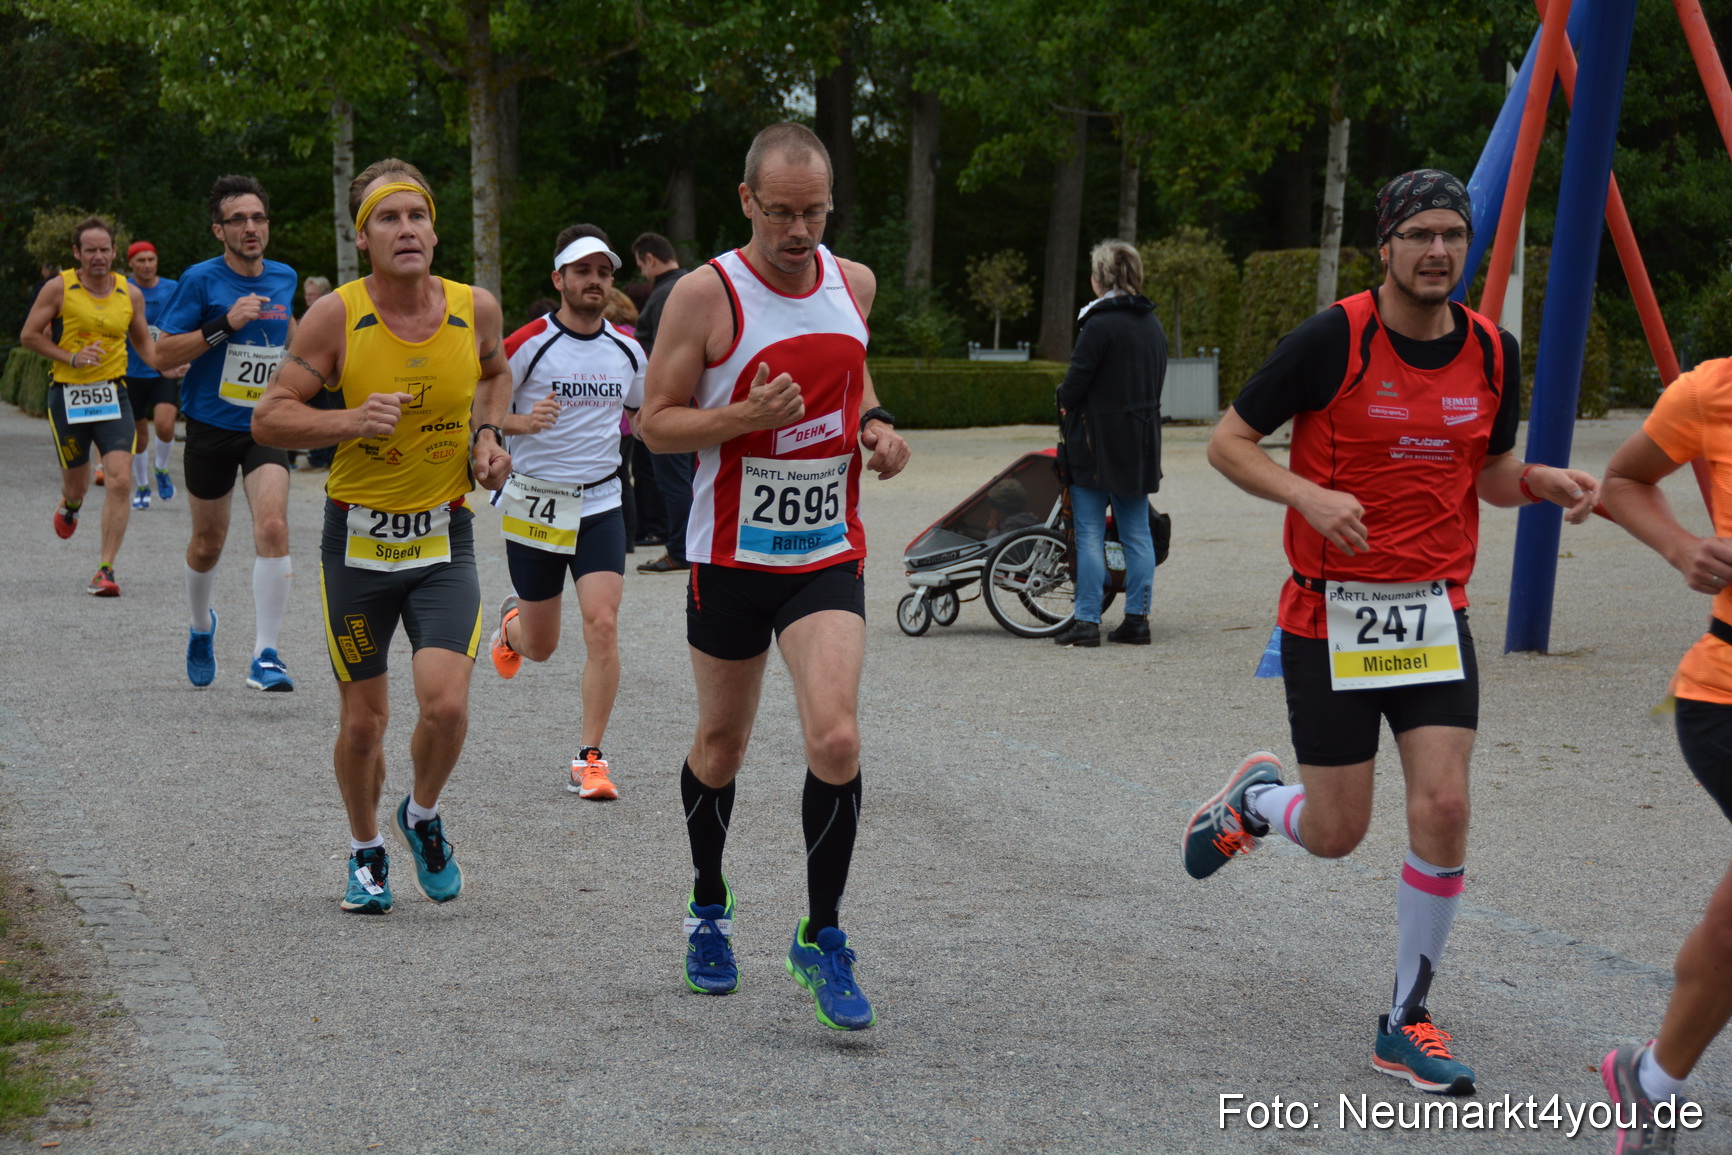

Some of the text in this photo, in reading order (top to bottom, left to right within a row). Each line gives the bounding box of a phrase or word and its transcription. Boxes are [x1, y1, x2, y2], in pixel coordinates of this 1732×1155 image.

[228, 350, 252, 359] PARTL
[70, 387, 113, 406] 2559
[552, 381, 622, 398] ERDINGER
[795, 423, 827, 443] DEHN
[1399, 436, 1450, 446] Gruber
[425, 441, 459, 453] PIZZERIA
[432, 449, 455, 460] ELIO
[745, 466, 836, 481] PARTL Neumarkt
[531, 486, 569, 497] Neumarkt
[525, 496, 557, 524] 74
[752, 481, 839, 526] 2695
[369, 510, 432, 538] 290
[529, 526, 548, 539] Tim
[772, 536, 821, 551] Rainer
[375, 544, 421, 560] Speedy
[1329, 589, 1427, 601] PARTL Neumarkt
[1355, 604, 1427, 644] 247
[350, 619, 374, 651] Run!
[345, 637, 358, 661] Team
[1363, 653, 1428, 672] Michael
